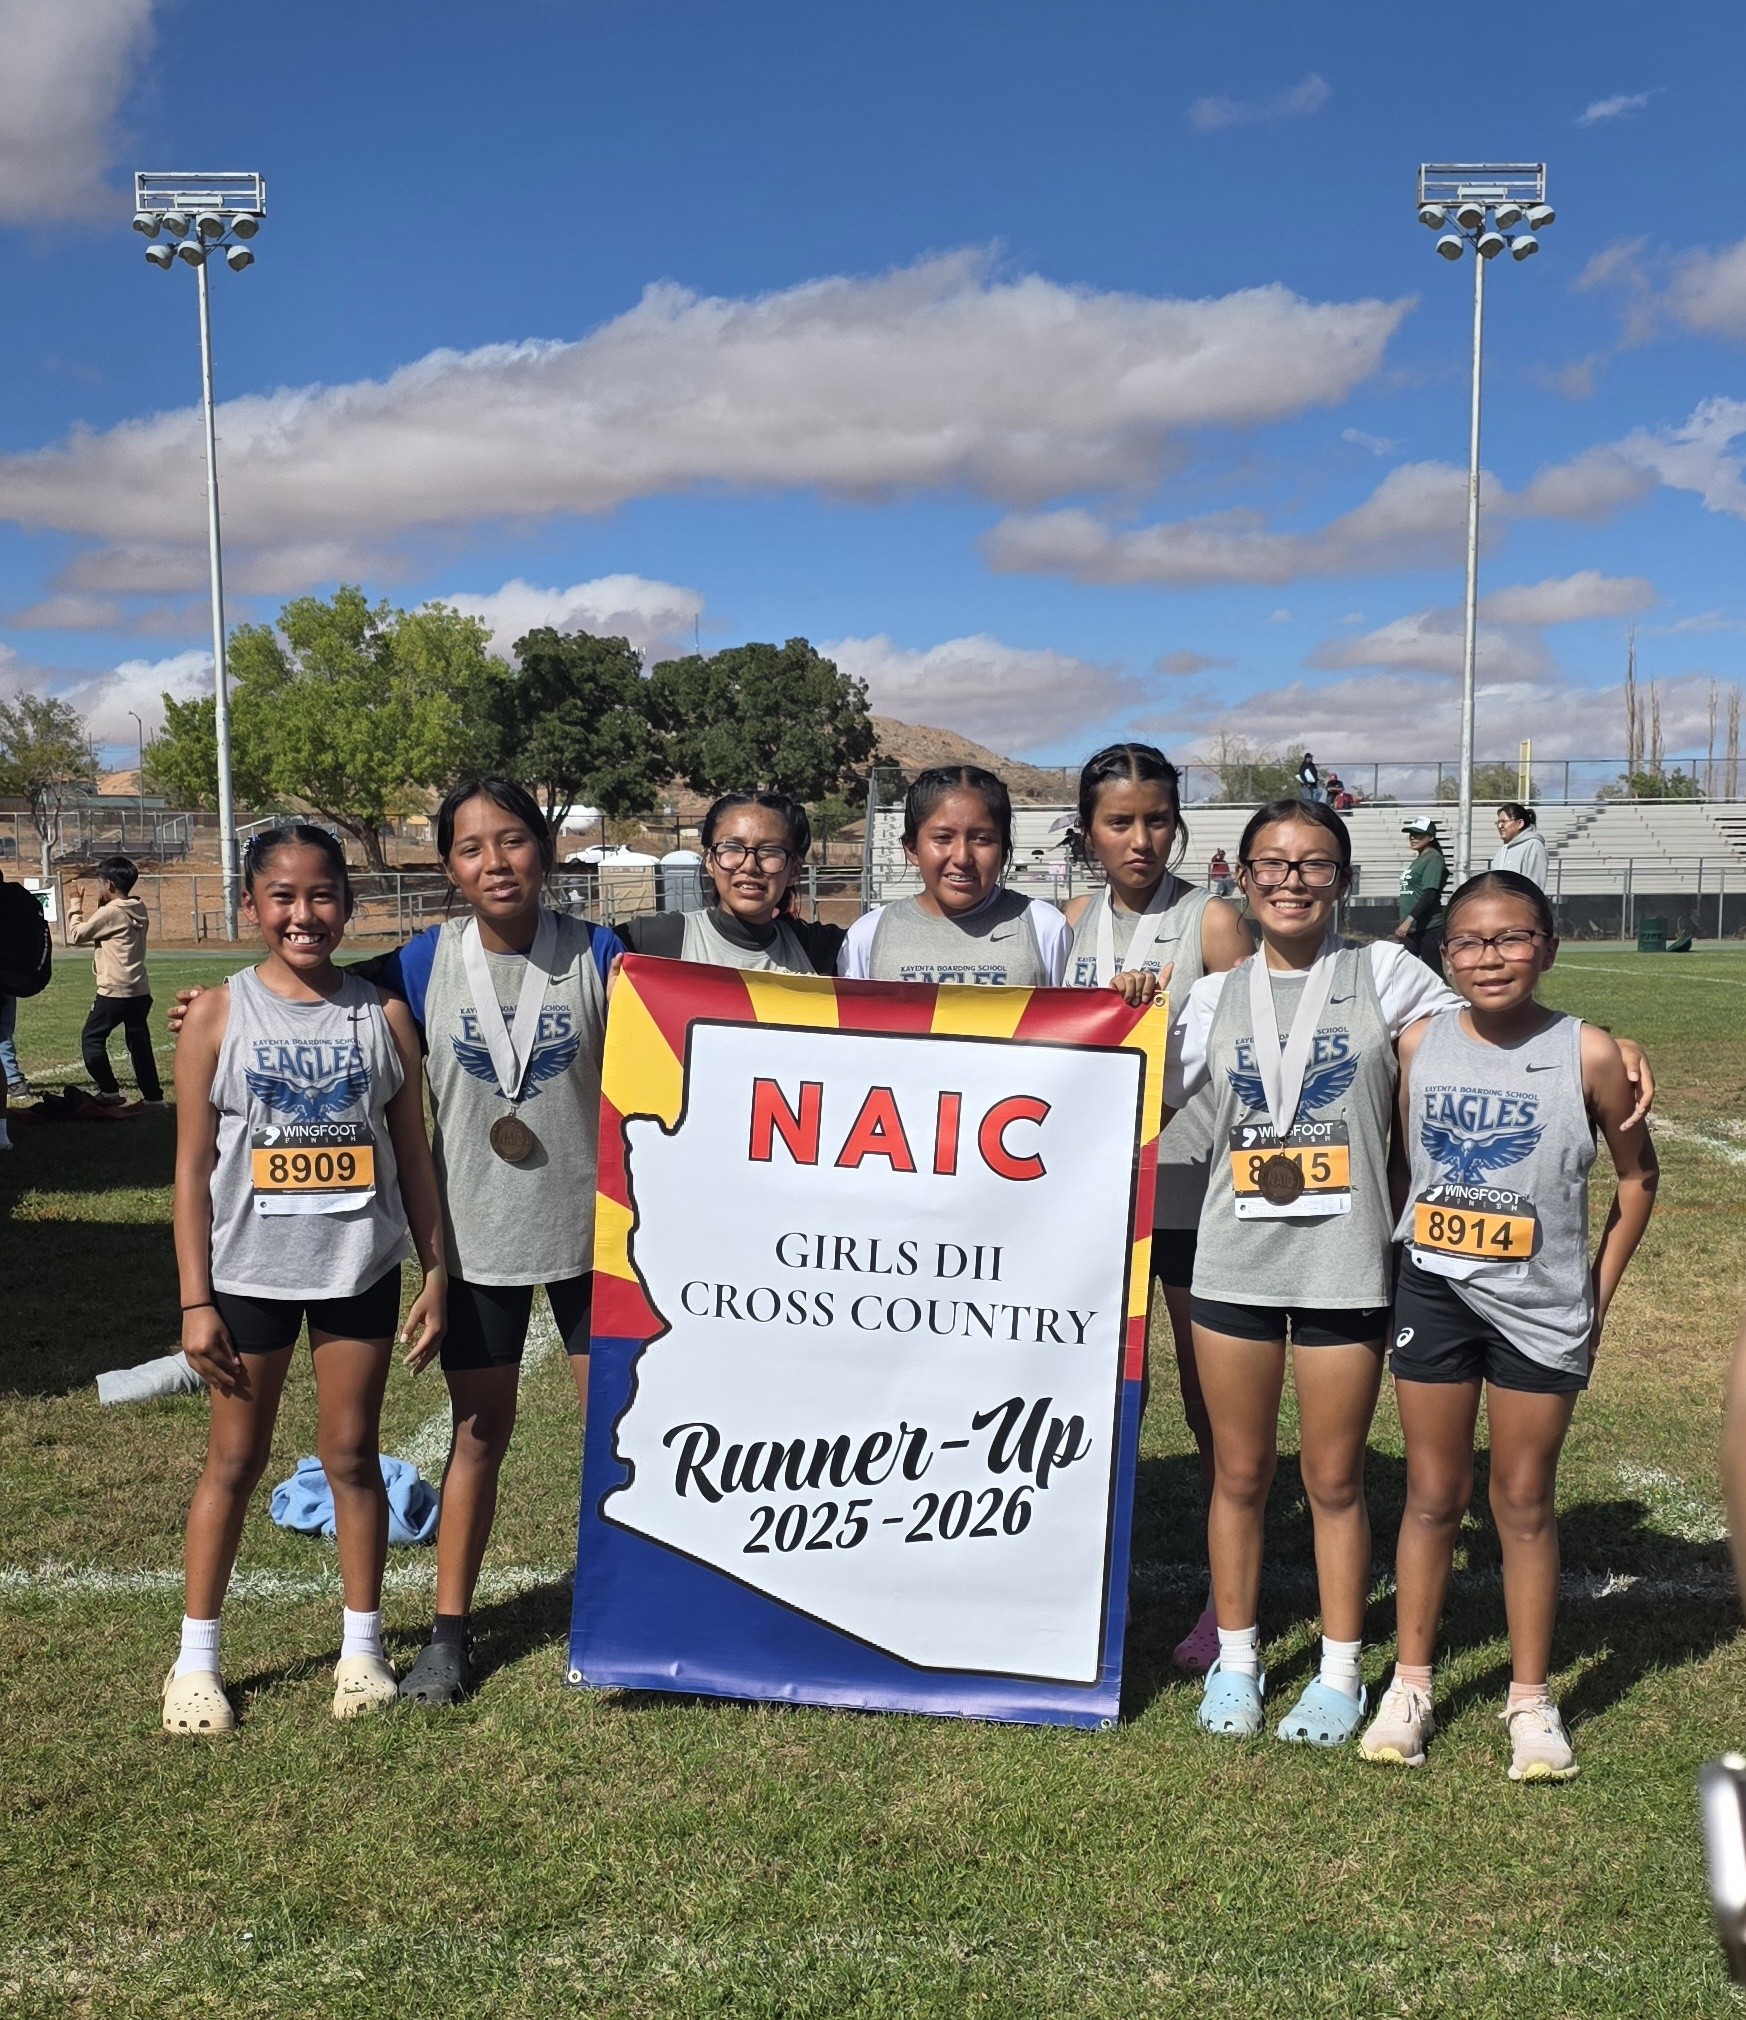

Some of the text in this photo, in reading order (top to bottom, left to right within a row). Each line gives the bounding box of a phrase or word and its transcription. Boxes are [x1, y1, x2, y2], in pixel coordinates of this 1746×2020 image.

[335, 1037, 363, 1046] SCHOL
[460, 1013, 572, 1043] EES
[1317, 1027, 1349, 1035] SCHOOL
[252, 1046, 364, 1082] EAGLES
[1235, 1034, 1350, 1072] EES
[1460, 1086, 1503, 1096] BOARDING
[1505, 1091, 1540, 1100] SCHOOL
[749, 1076, 1053, 1182] NAIC
[1424, 1093, 1540, 1133] EAGLES
[282, 1124, 357, 1138] WINGFOOT
[284, 1136, 356, 1144] FINISH
[1258, 1122, 1333, 1138] WIFOOT
[269, 1151, 356, 1183] 8909
[1248, 1152, 1332, 1186] 815
[1444, 1195, 1518, 1212] FINISH
[1445, 1184, 1522, 1205] WINGFOOT
[1428, 1211, 1513, 1251] 8914
[776, 1232, 1004, 1282] GIRLS DII
[681, 1281, 1099, 1345] CROSS COUNTRY
[663, 1397, 1092, 1504] Runner-Up
[743, 1485, 1035, 1554] 2025-2026
